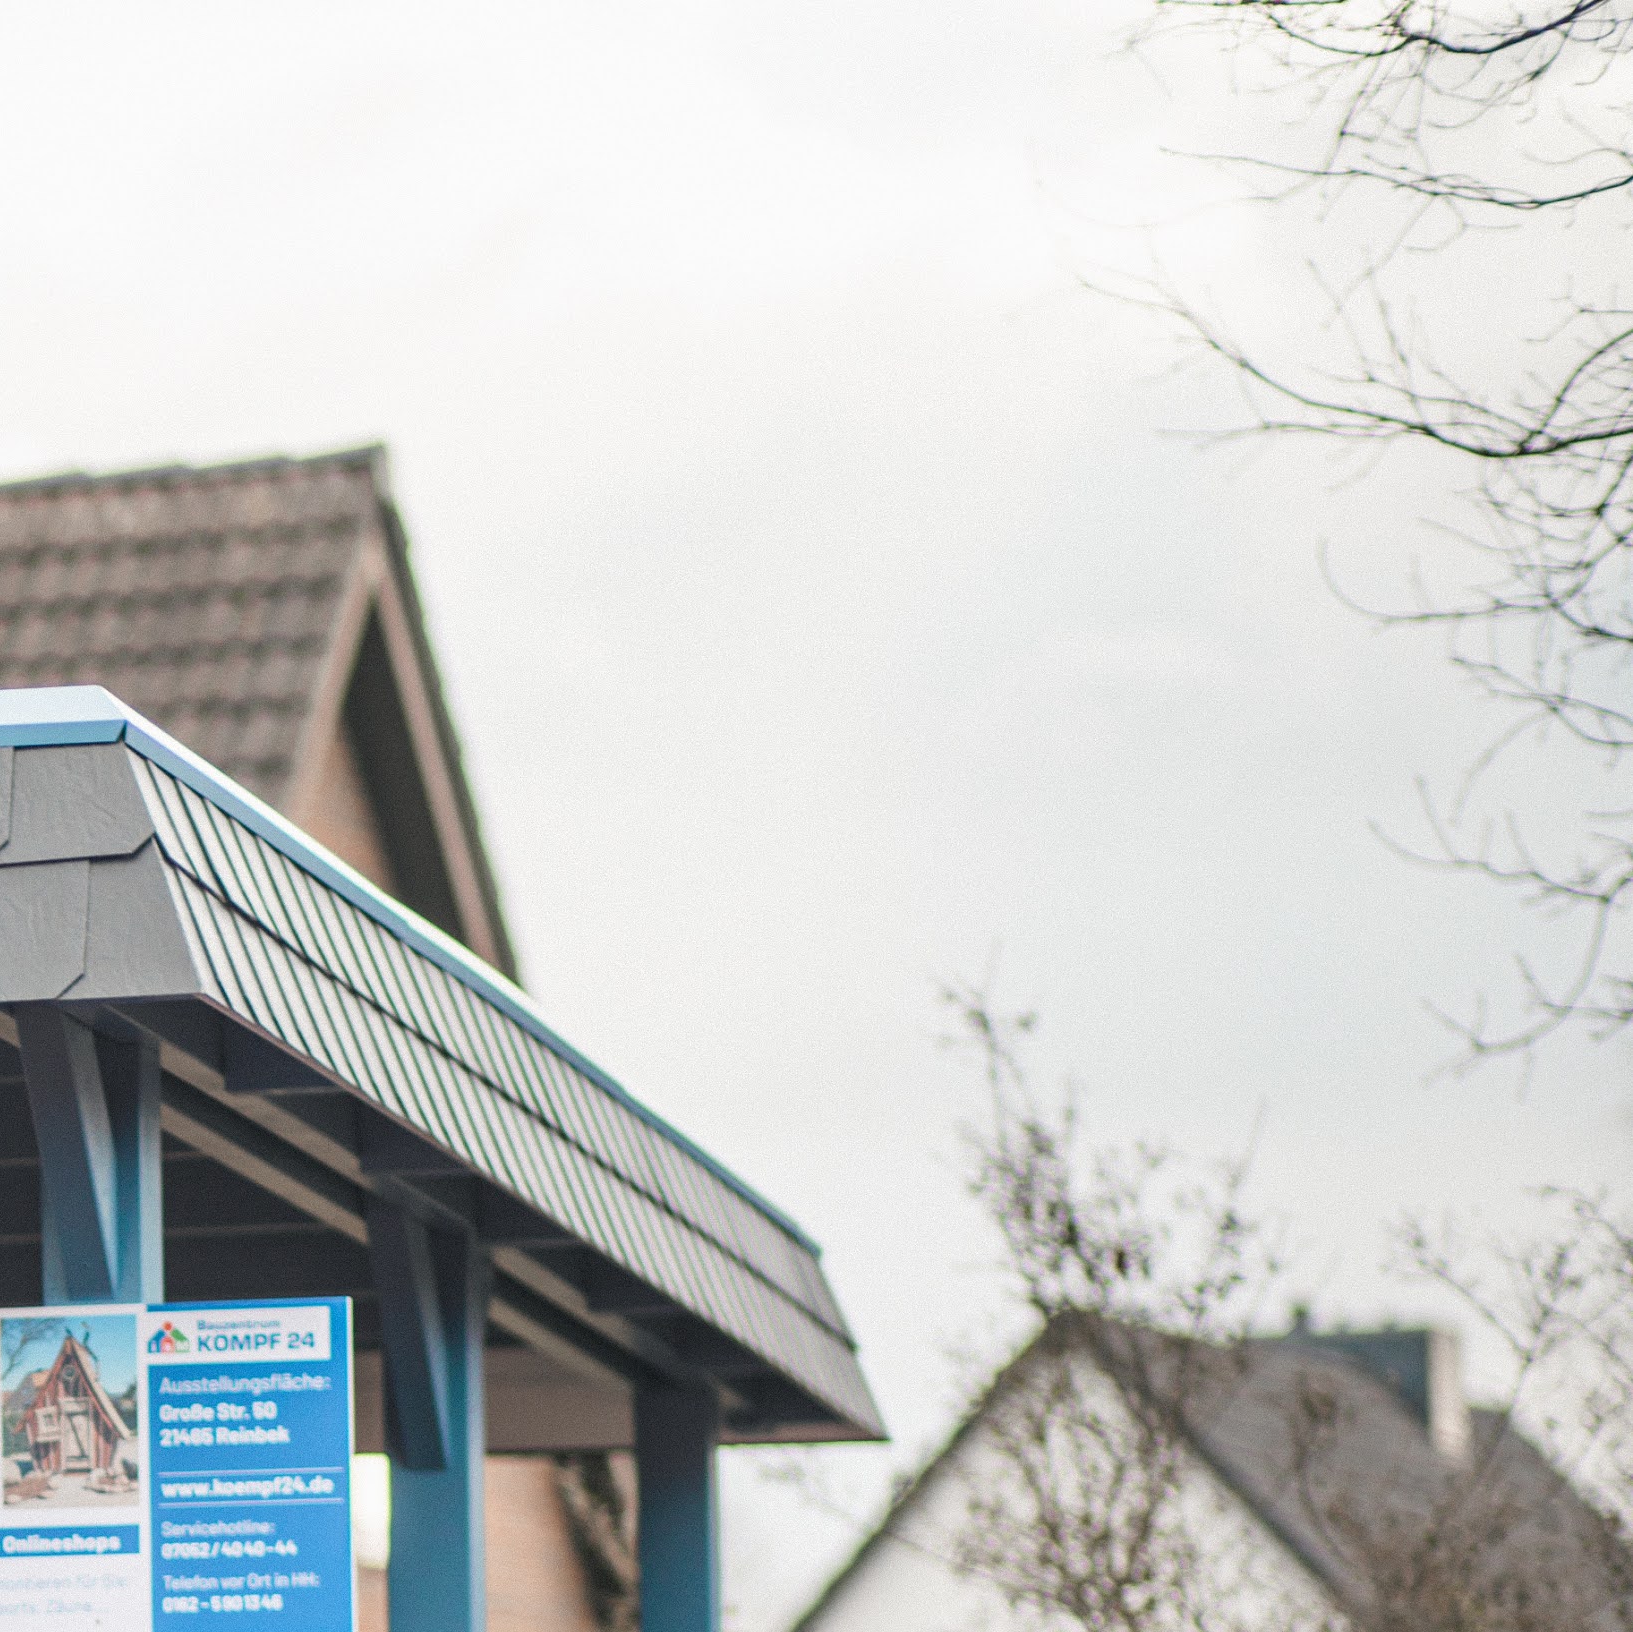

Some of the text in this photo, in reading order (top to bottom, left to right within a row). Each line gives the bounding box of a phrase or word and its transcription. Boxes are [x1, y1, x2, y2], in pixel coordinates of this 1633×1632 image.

[287, 1331, 315, 1350] 24
[159, 1403, 215, 1423] Große
[217, 1402, 250, 1421] Str.
[216, 1425, 291, 1445] Reinbek
[160, 1475, 335, 1499] www.koempf24.de
[2, 1533, 122, 1555] Onlineshops
[162, 1574, 219, 1591] Telefon
[220, 1576, 245, 1590] vor
[246, 1572, 272, 1589] Ort
[273, 1572, 290, 1588] in
